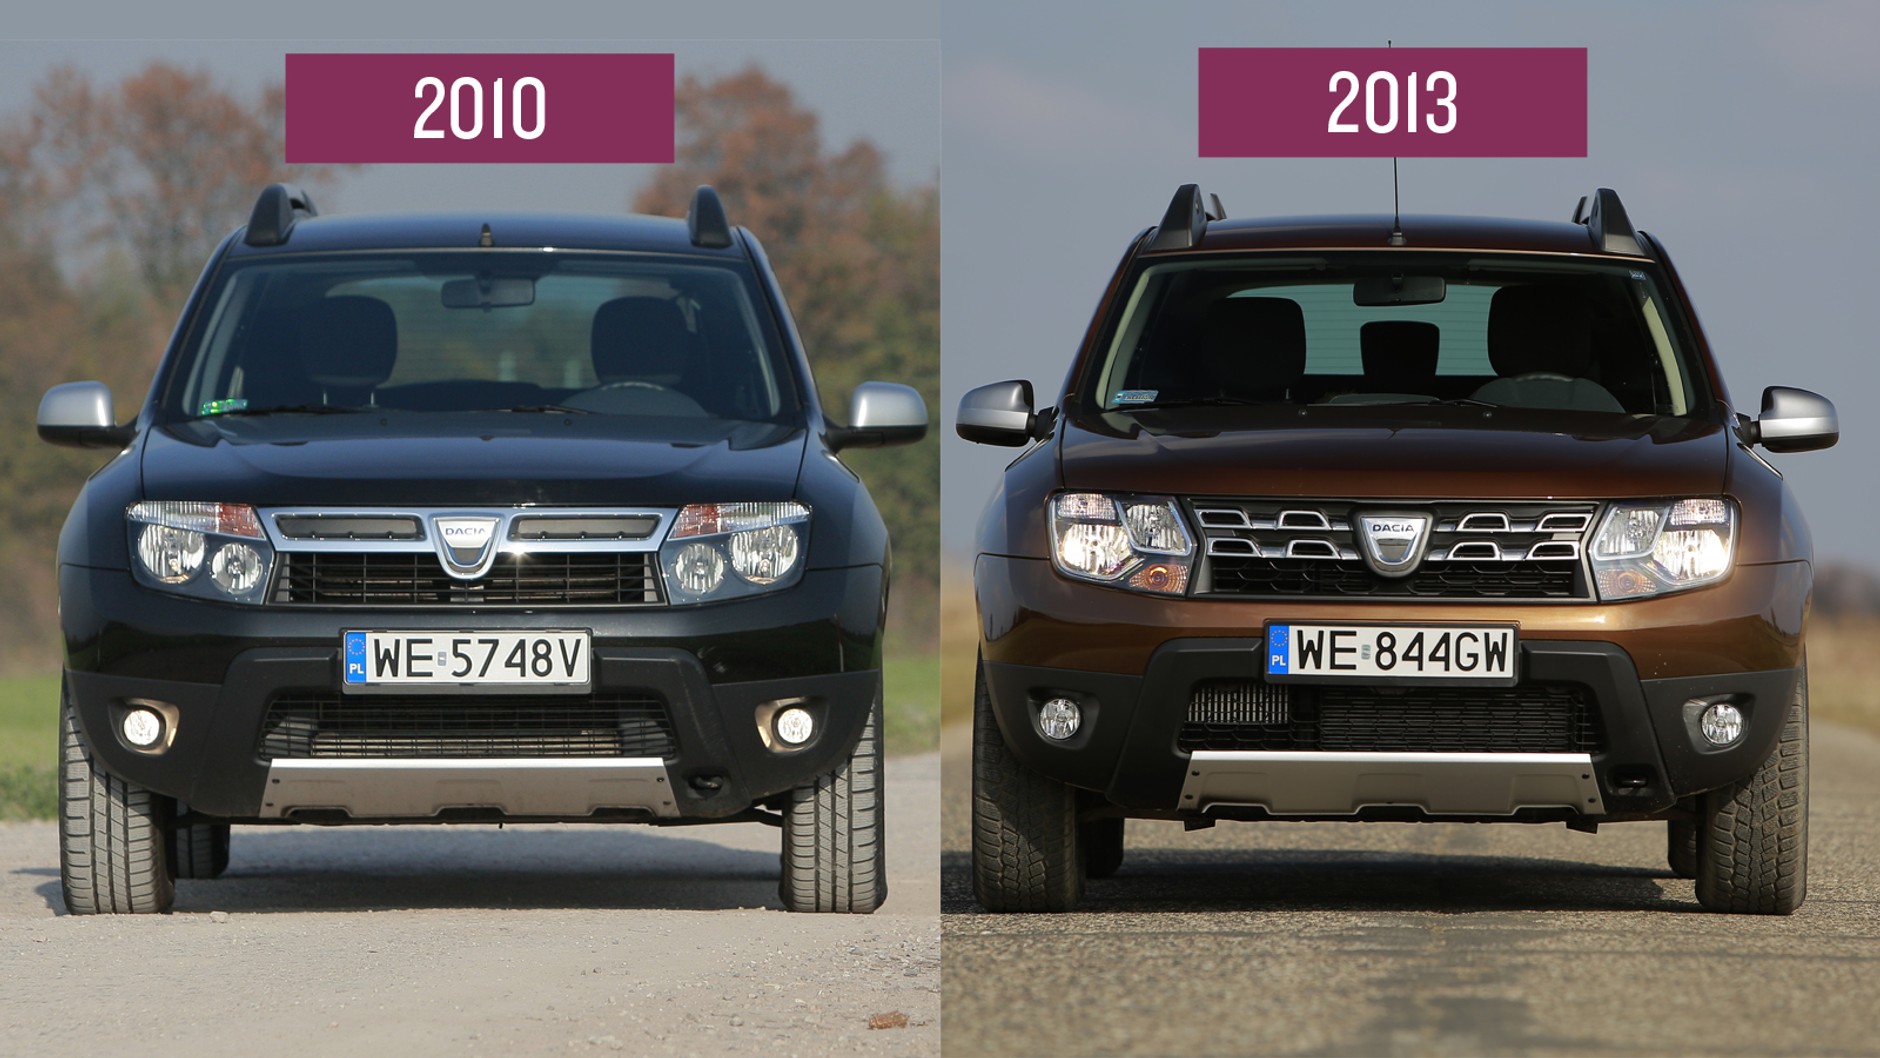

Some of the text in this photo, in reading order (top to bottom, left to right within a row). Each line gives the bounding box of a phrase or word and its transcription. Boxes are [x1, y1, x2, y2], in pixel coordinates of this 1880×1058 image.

[445, 527, 487, 536] DACIA
[1372, 524, 1415, 533] DACIA
[1296, 629, 1509, 672] WE 844GW
[373, 638, 582, 678] WE 5748V
[1271, 655, 1287, 667] PL
[349, 663, 364, 675] PL
